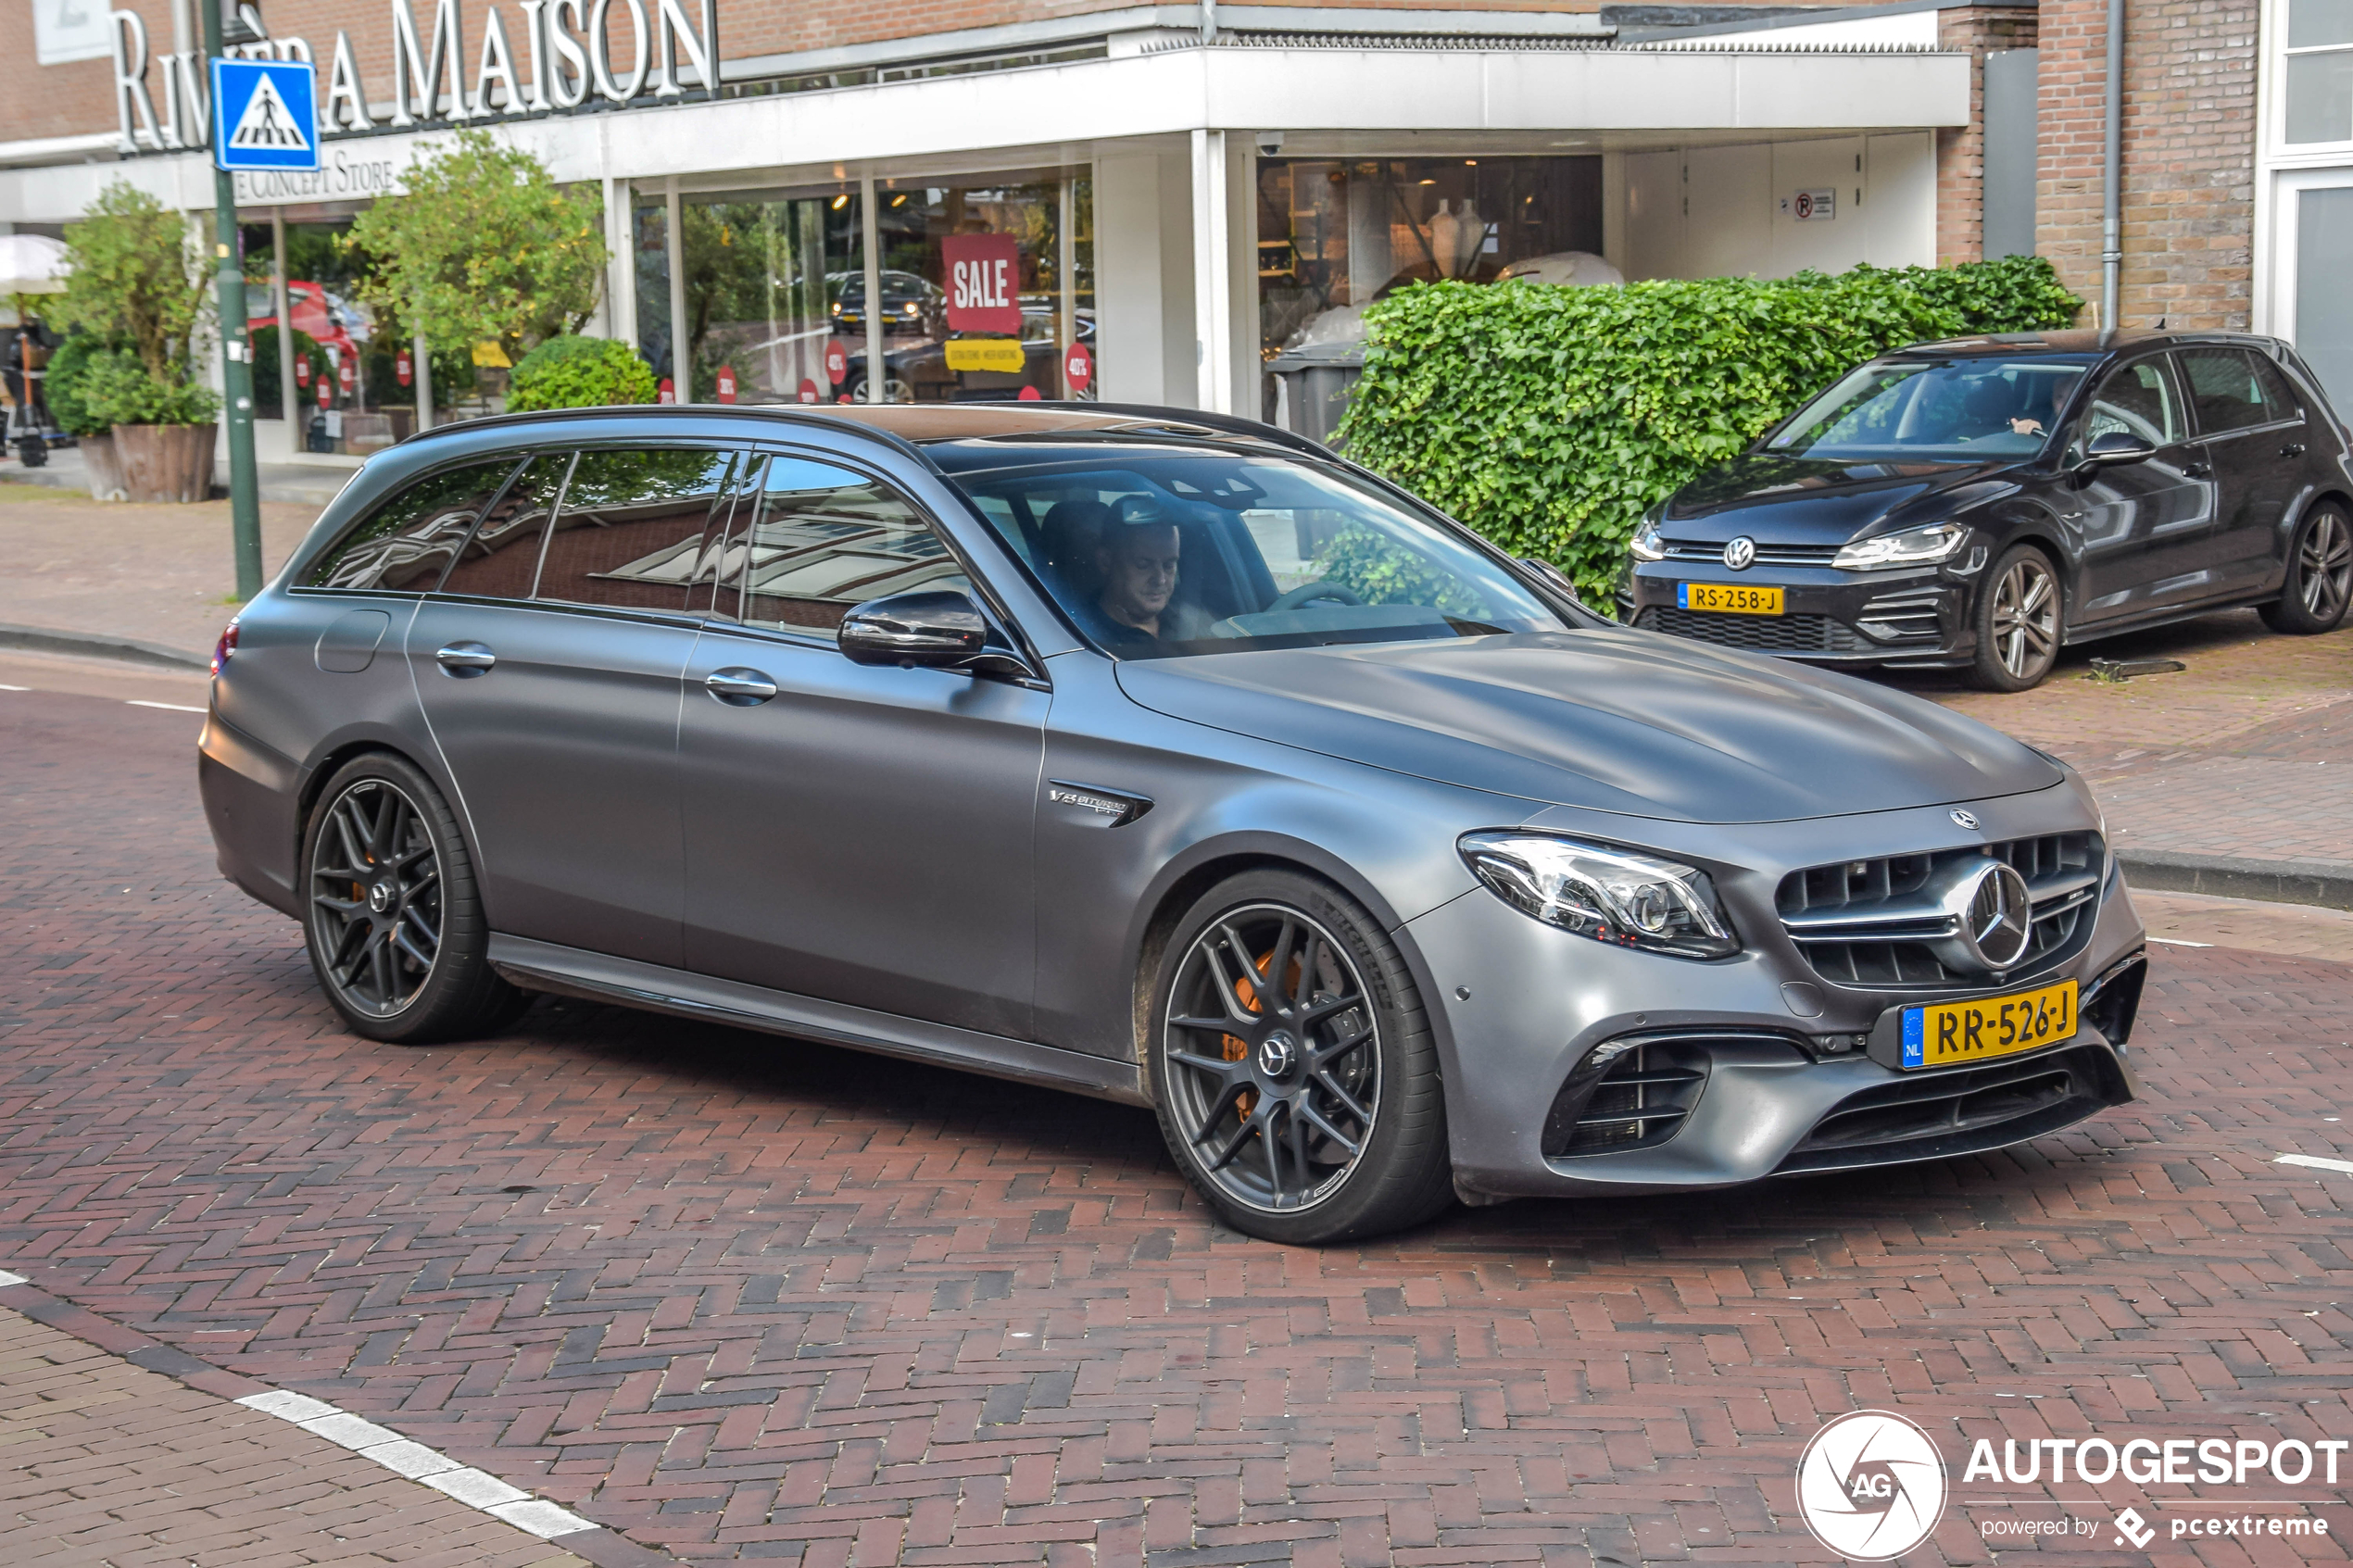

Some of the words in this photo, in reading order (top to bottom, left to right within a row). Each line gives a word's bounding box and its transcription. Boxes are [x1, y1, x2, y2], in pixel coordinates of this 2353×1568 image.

[110, 4, 375, 154] RIVA
[390, 0, 721, 127] MAISON
[250, 167, 330, 199] CONCEPT
[335, 150, 395, 193] STORE
[953, 259, 1009, 309] SALE
[1068, 357, 1088, 376] 40%
[1695, 588, 1776, 610] RS-258-J
[1050, 790, 1077, 806] V8
[1077, 797, 1126, 811] BITURBO
[1328, 908, 1392, 1003] MICHELIN
[1938, 990, 2068, 1055] RR-526-J
[1906, 1044, 1921, 1058] NL
